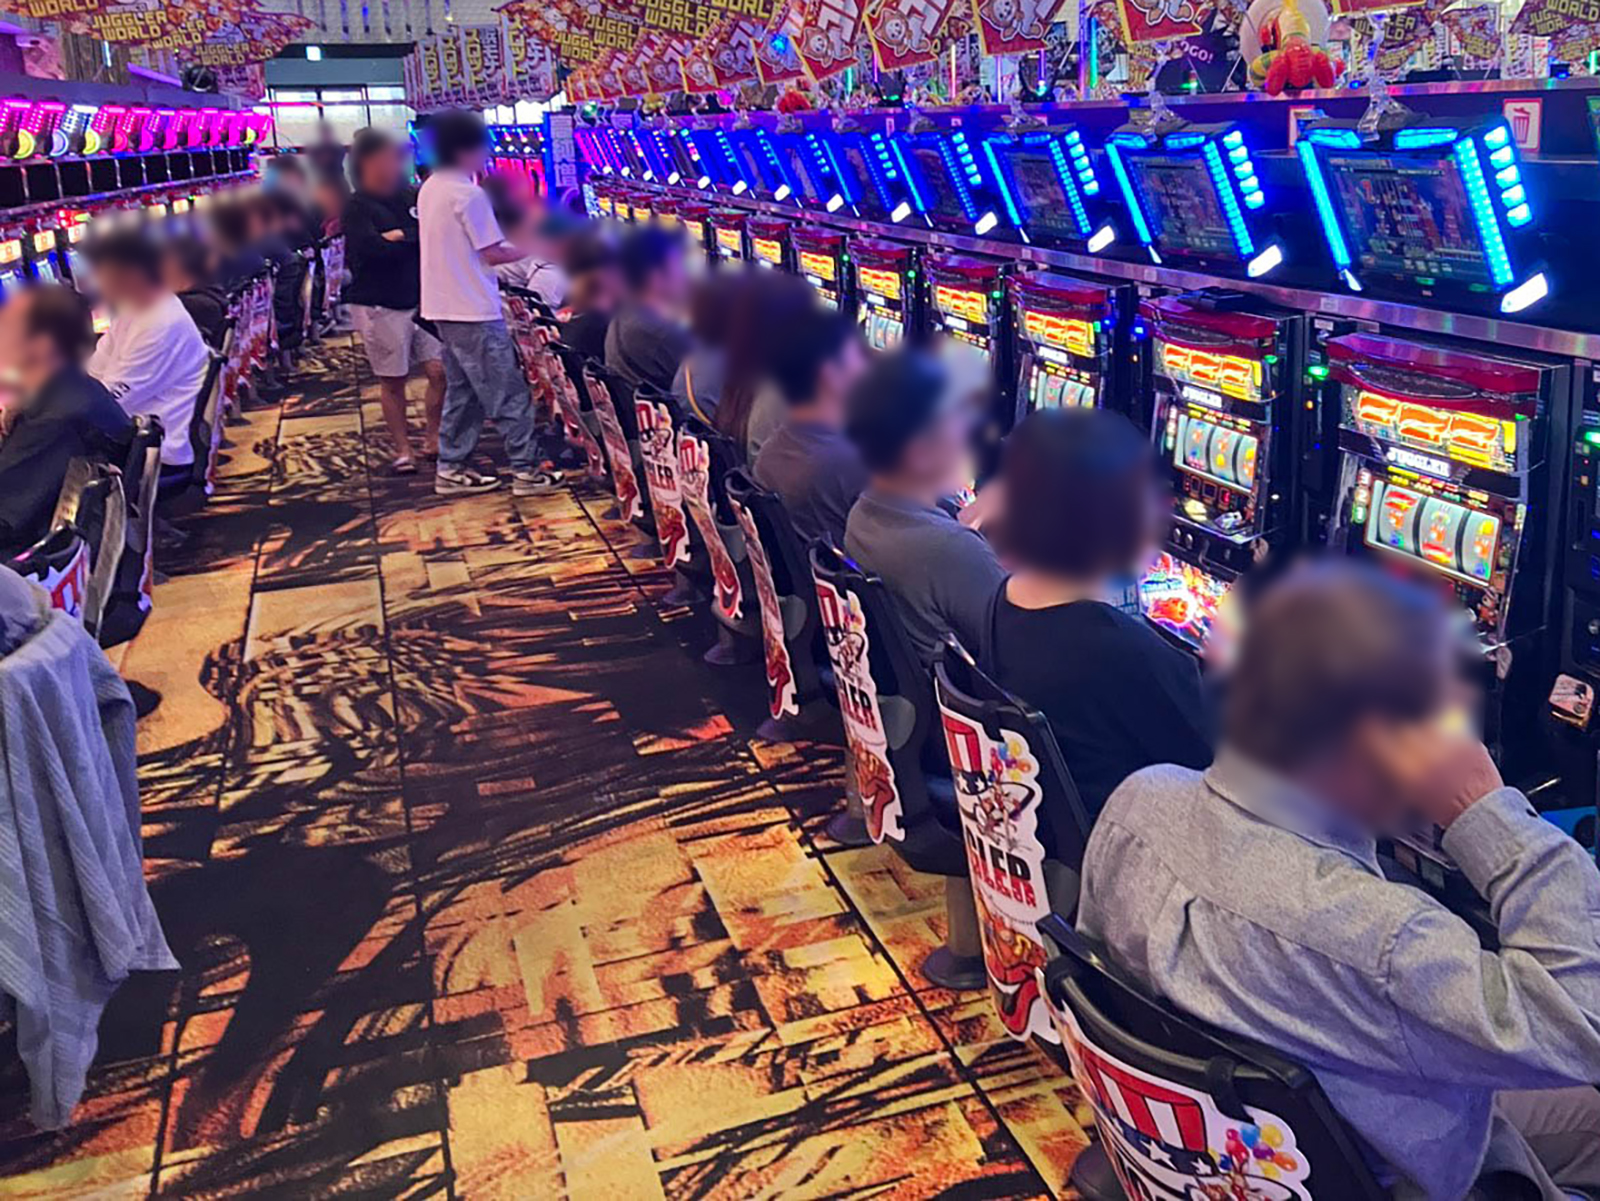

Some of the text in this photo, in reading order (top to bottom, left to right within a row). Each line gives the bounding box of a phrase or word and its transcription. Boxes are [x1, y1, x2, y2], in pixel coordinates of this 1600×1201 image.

[29, 0, 99, 17] WORLD
[92, 11, 167, 28] JUGGLER
[644, 9, 708, 39] WORLD
[102, 25, 161, 40] WORLD
[152, 31, 203, 49] WORLD
